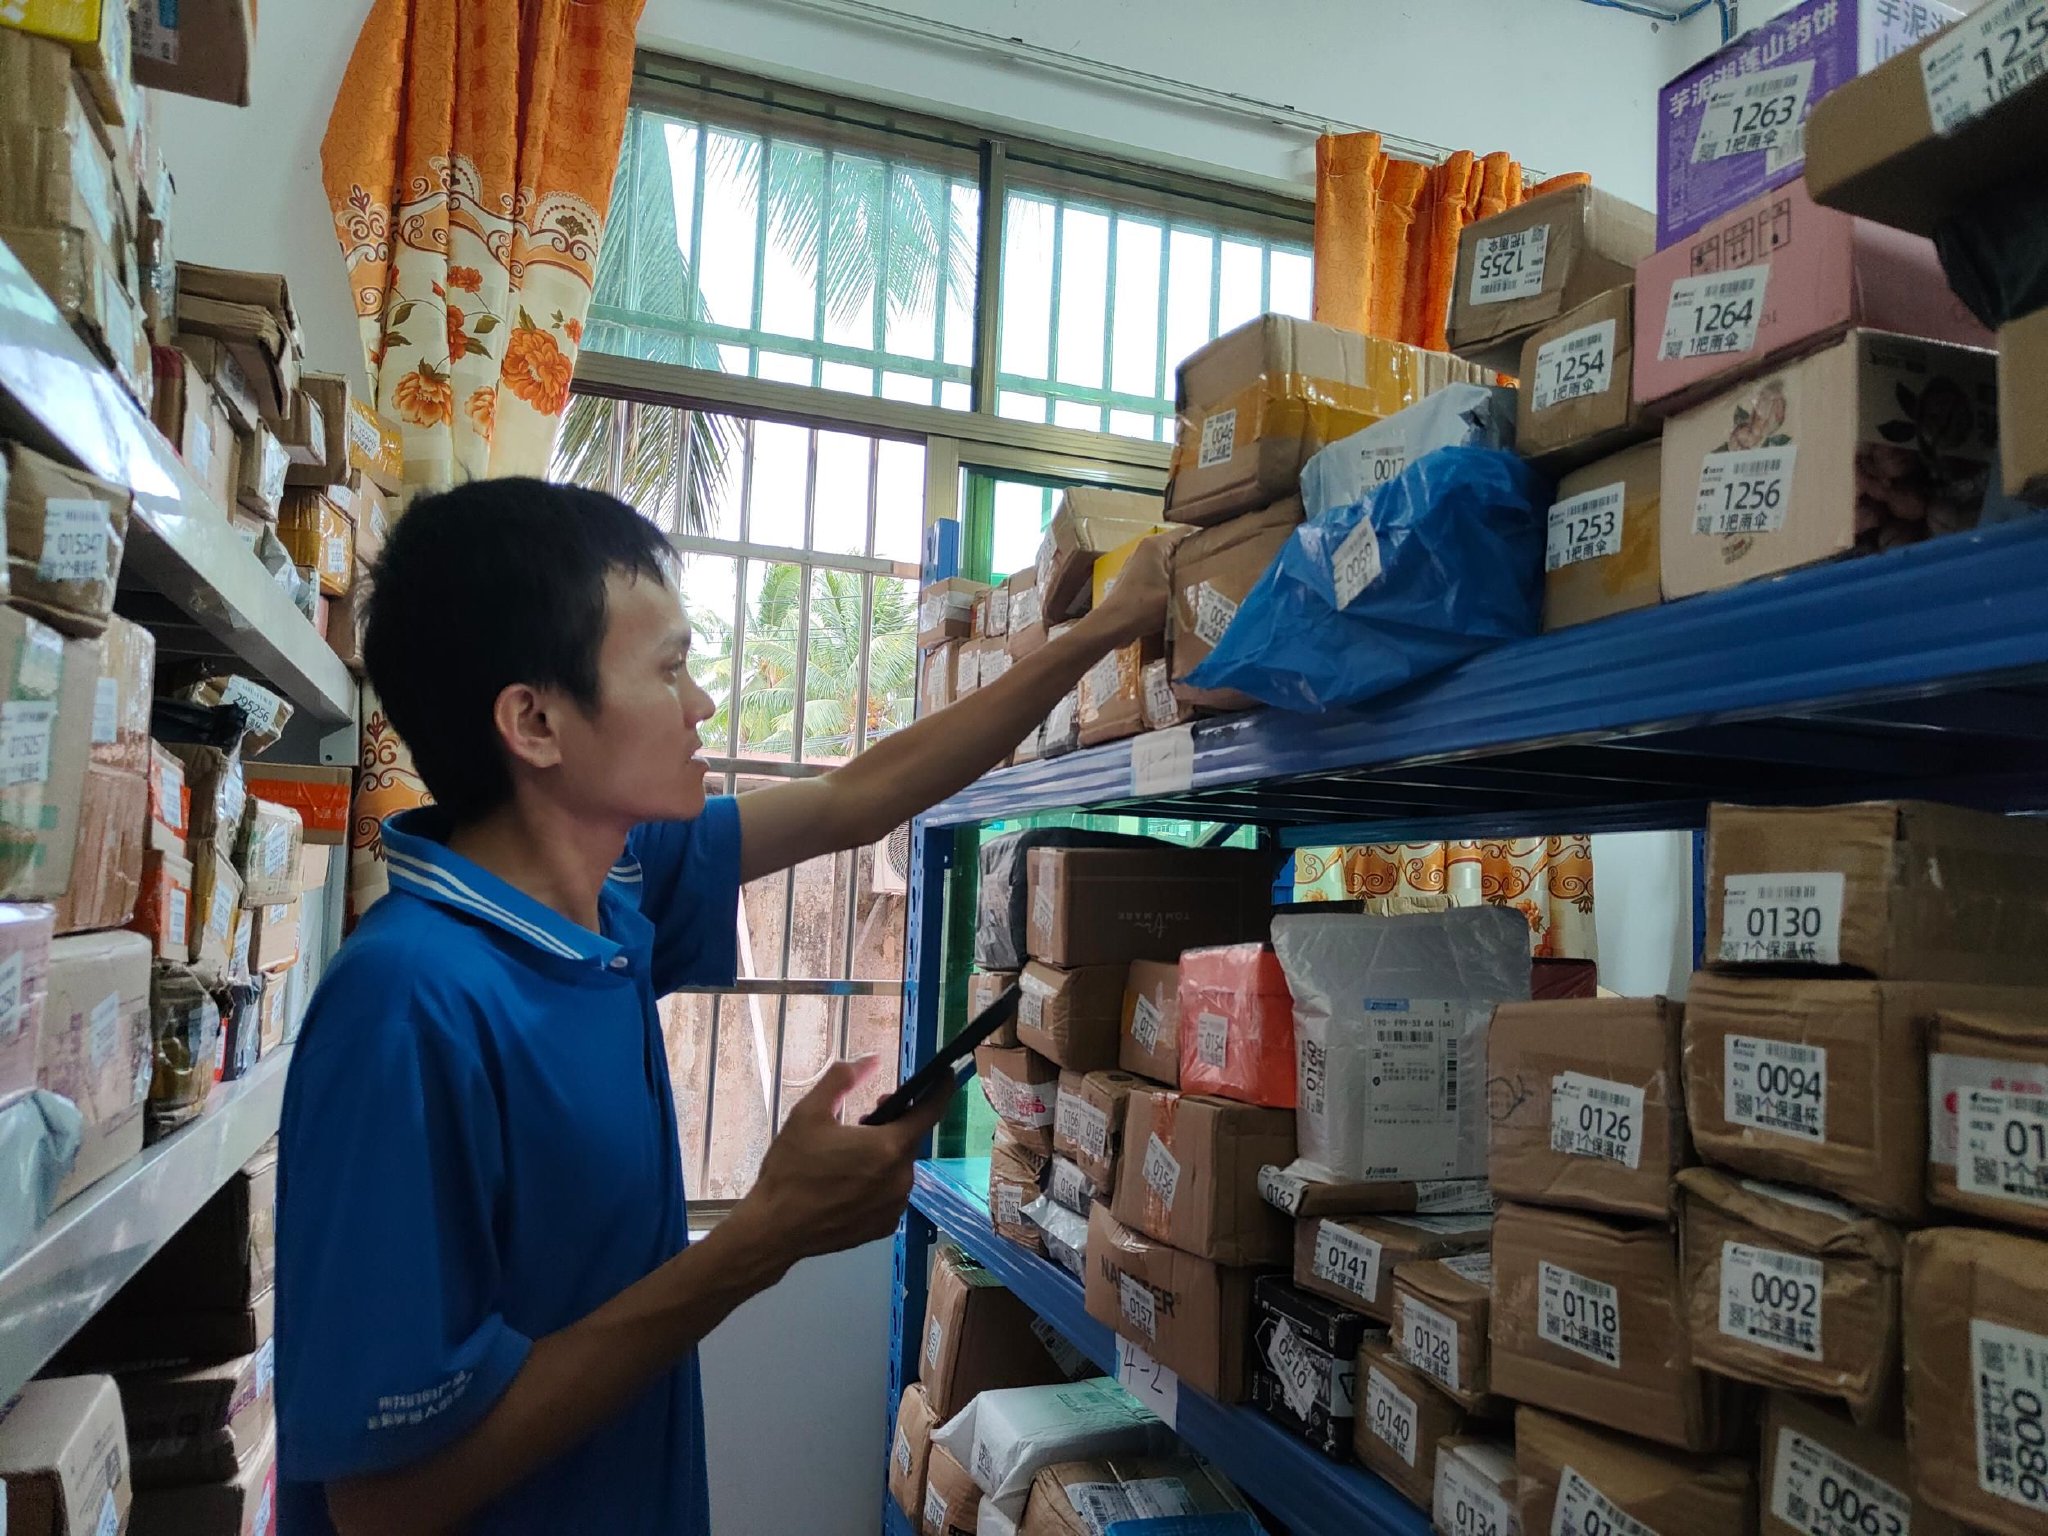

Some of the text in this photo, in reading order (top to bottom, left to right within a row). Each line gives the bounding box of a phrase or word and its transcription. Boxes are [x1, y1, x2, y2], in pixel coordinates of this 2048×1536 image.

[1732, 95, 1796, 134] 1263
[1726, 129, 1779, 152] 1把雨伞
[1488, 234, 1526, 252] 1把雨伞
[1479, 250, 1524, 279] 1255
[1693, 298, 1754, 335] 1264
[1690, 331, 1739, 353] 1把雨伞
[1555, 349, 1604, 384] 1254
[1552, 378, 1594, 399] 1把雨伞
[1374, 457, 1405, 481] 0017
[1724, 478, 1781, 510] 1256
[1566, 511, 1615, 545] 1253
[1720, 511, 1768, 531] 1把雨伞
[1565, 539, 1607, 560] 1把雨伞
[233, 692, 270, 723] 295256
[1747, 906, 1822, 937] 0130
[1743, 940, 1816, 959] 1个保温杯
[1306, 1039, 1317, 1091] 0160
[1757, 1061, 1822, 1104] 0094
[1063, 1109, 1079, 1131] 0166
[1579, 1103, 1632, 1142] 0126
[1755, 1096, 1818, 1124] 1个保温杯
[1575, 1132, 1627, 1160] 1个保温杯
[1153, 1159, 1173, 1195] 0156
[1266, 1183, 1294, 1213] 0162
[1328, 1246, 1367, 1281] 0141
[1129, 1297, 1152, 1326] 0157
[1563, 1289, 1617, 1333] 0118
[1751, 1271, 1816, 1318] 0092
[1561, 1318, 1615, 1353] 1个保温杯
[1748, 1306, 1813, 1340] 1个保温杯
[1414, 1325, 1450, 1366] 0128
[1278, 1338, 1308, 1389] 0150
[1376, 1398, 1410, 1442] 0140
[2011, 1387, 2048, 1501] 0086
[1820, 1476, 1902, 1536] 0063
